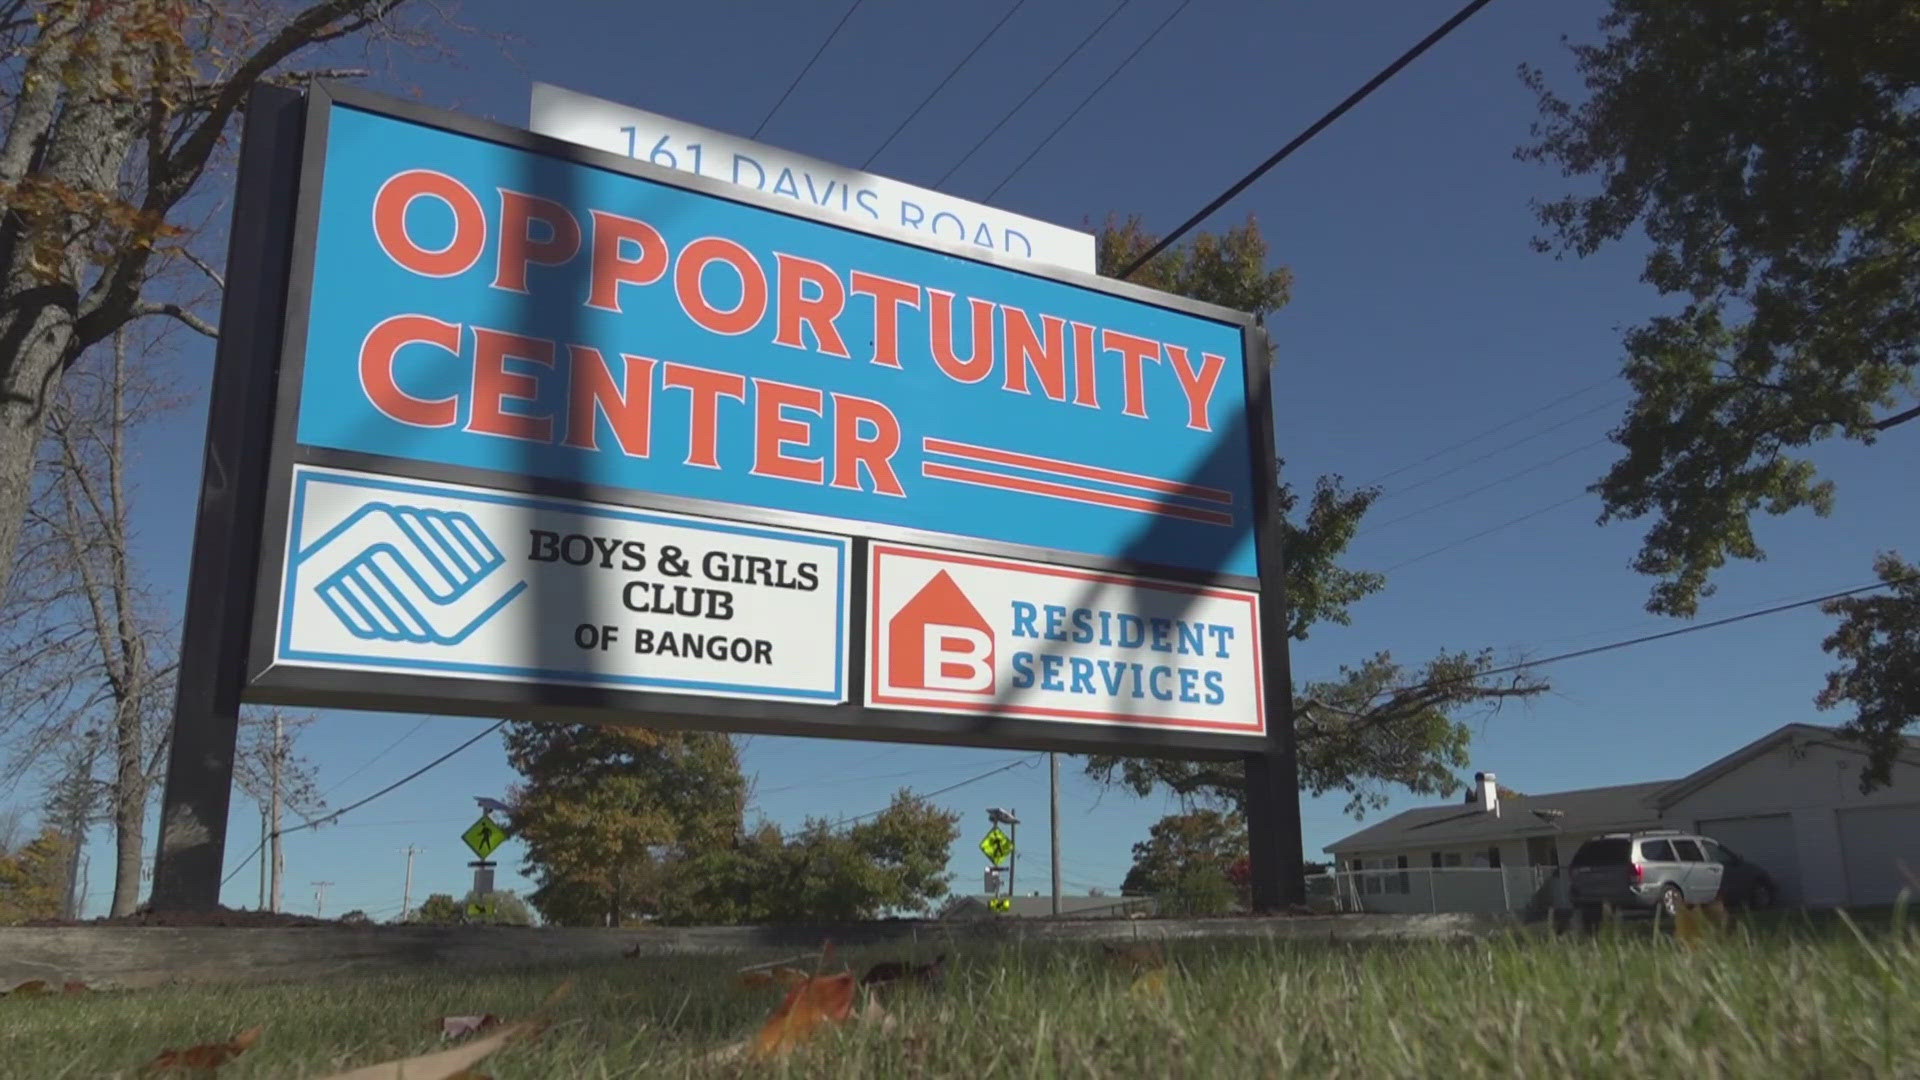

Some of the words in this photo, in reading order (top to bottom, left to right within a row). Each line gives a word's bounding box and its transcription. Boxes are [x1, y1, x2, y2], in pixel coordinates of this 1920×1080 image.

[619, 125, 702, 177] 161
[732, 153, 880, 220] DAVIS
[371, 168, 1226, 432] OPPORTUNITY
[358, 313, 907, 498] CENTER
[528, 529, 646, 571] BOYS
[657, 545, 692, 578] &
[702, 551, 819, 592] GIRLS
[622, 581, 734, 620] CLUB
[1011, 601, 1234, 659] RESIDENT
[574, 623, 618, 651] OF
[634, 629, 773, 665] BANGOR
[924, 623, 993, 692] B
[1012, 651, 1225, 706] SERVICES
